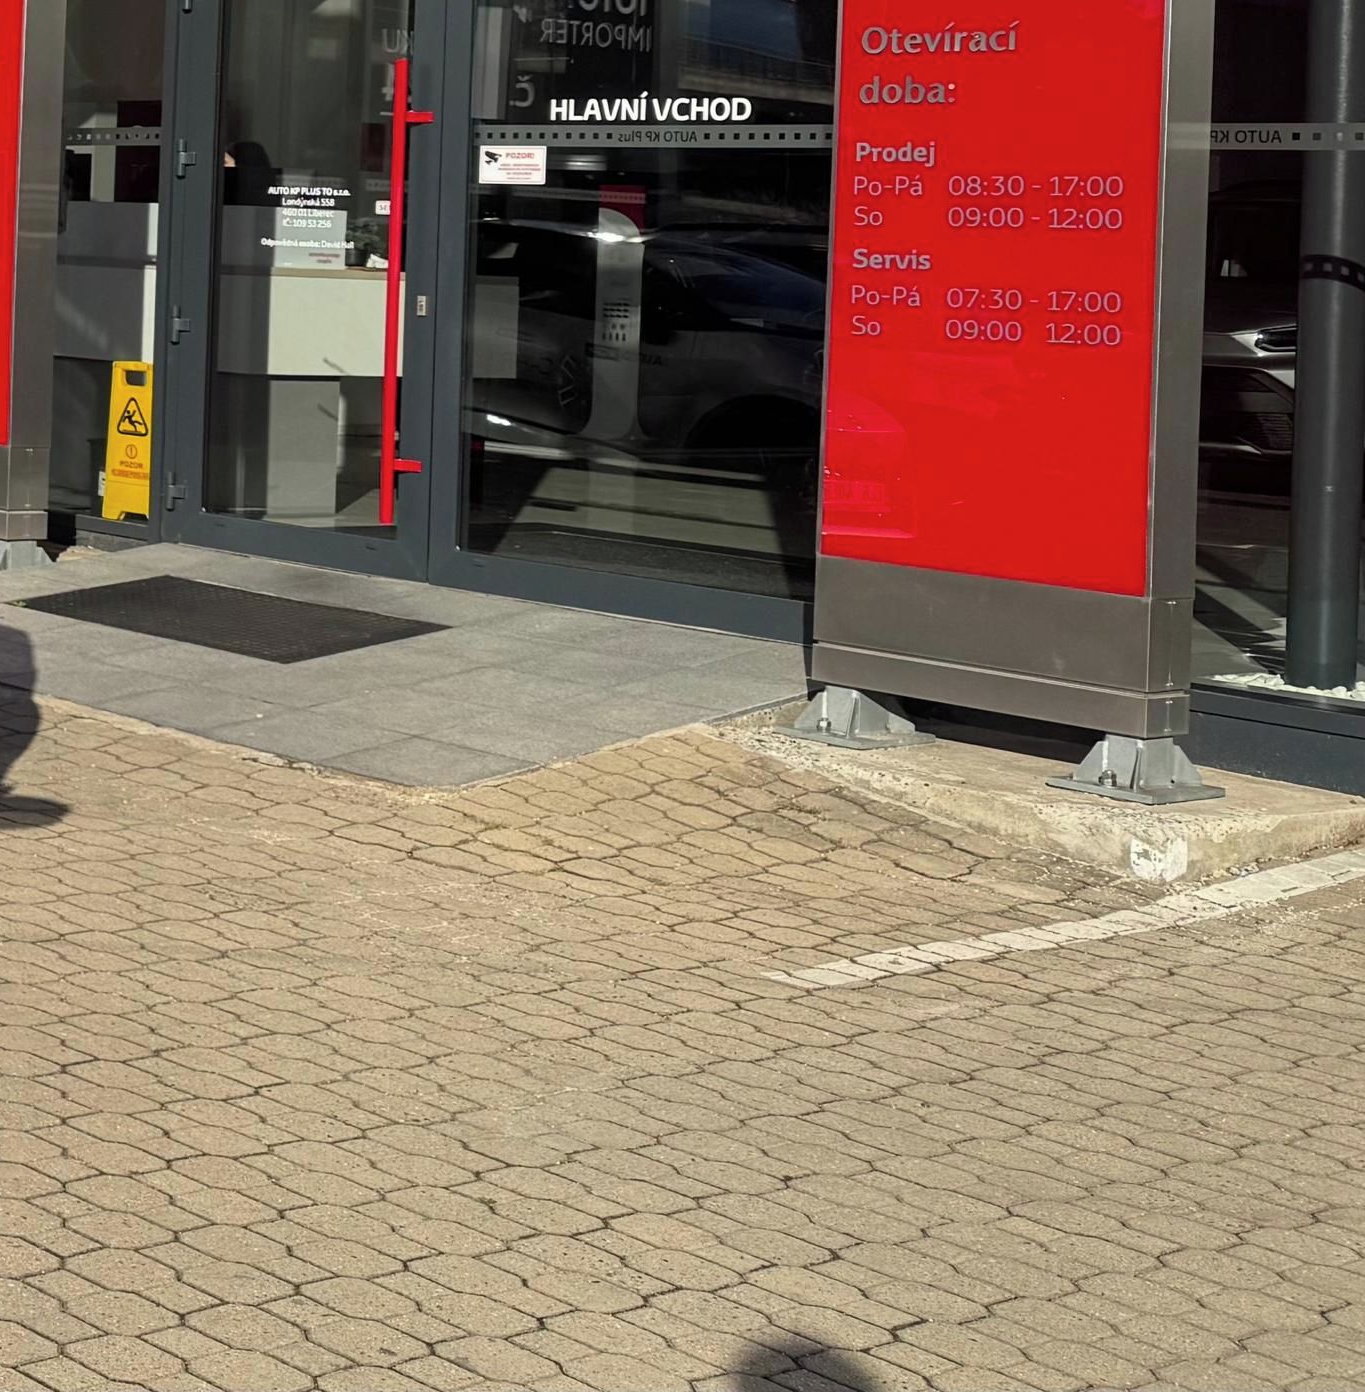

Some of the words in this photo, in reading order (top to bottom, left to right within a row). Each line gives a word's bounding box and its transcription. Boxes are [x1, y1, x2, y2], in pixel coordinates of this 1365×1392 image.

[861, 20, 1020, 54] Otevírací
[859, 75, 956, 104] doba:
[549, 91, 649, 121] HLAVNÍ
[652, 97, 753, 121] VCHOD
[855, 141, 936, 167] Prodej
[853, 175, 923, 196] Po-Pá
[948, 176, 1024, 196] 08:30
[1049, 176, 1124, 196] 17:00
[853, 206, 883, 226] So
[948, 207, 1024, 227] 09:00
[1048, 208, 1122, 229] 12:00
[852, 248, 931, 270] Servis
[851, 285, 921, 306] Po-Pá
[946, 288, 1022, 310] 07:30
[1047, 291, 1122, 313] 17:00
[851, 316, 881, 336] So
[946, 319, 1022, 342] 09:00
[1045, 323, 1121, 346] 12:00
